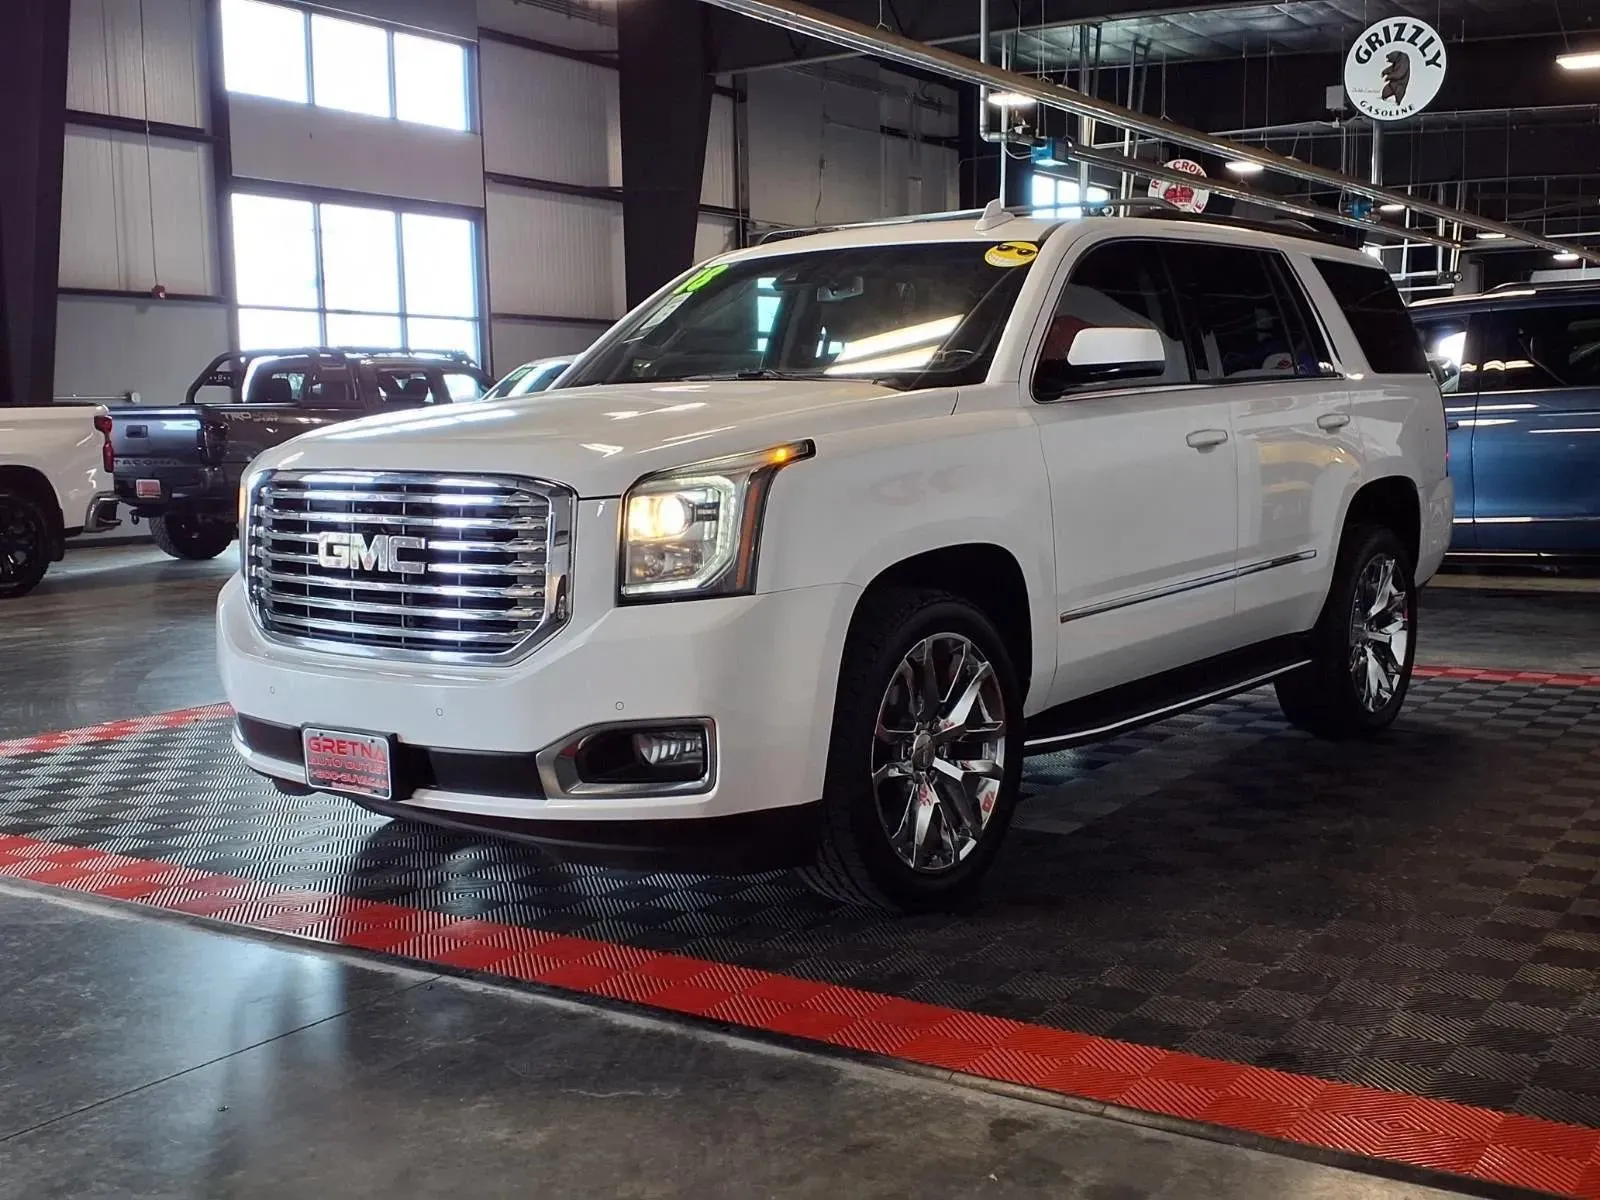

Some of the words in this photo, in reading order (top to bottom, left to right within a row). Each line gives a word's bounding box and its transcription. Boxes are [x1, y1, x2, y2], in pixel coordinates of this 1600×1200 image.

[1355, 23, 1442, 68] GRIZZLY
[1360, 100, 1415, 117] GASOLINE
[318, 531, 426, 574] GMC
[308, 736, 386, 763] GRETNA
[309, 756, 342, 768] AUTO
[345, 761, 387, 775] OUTLET
